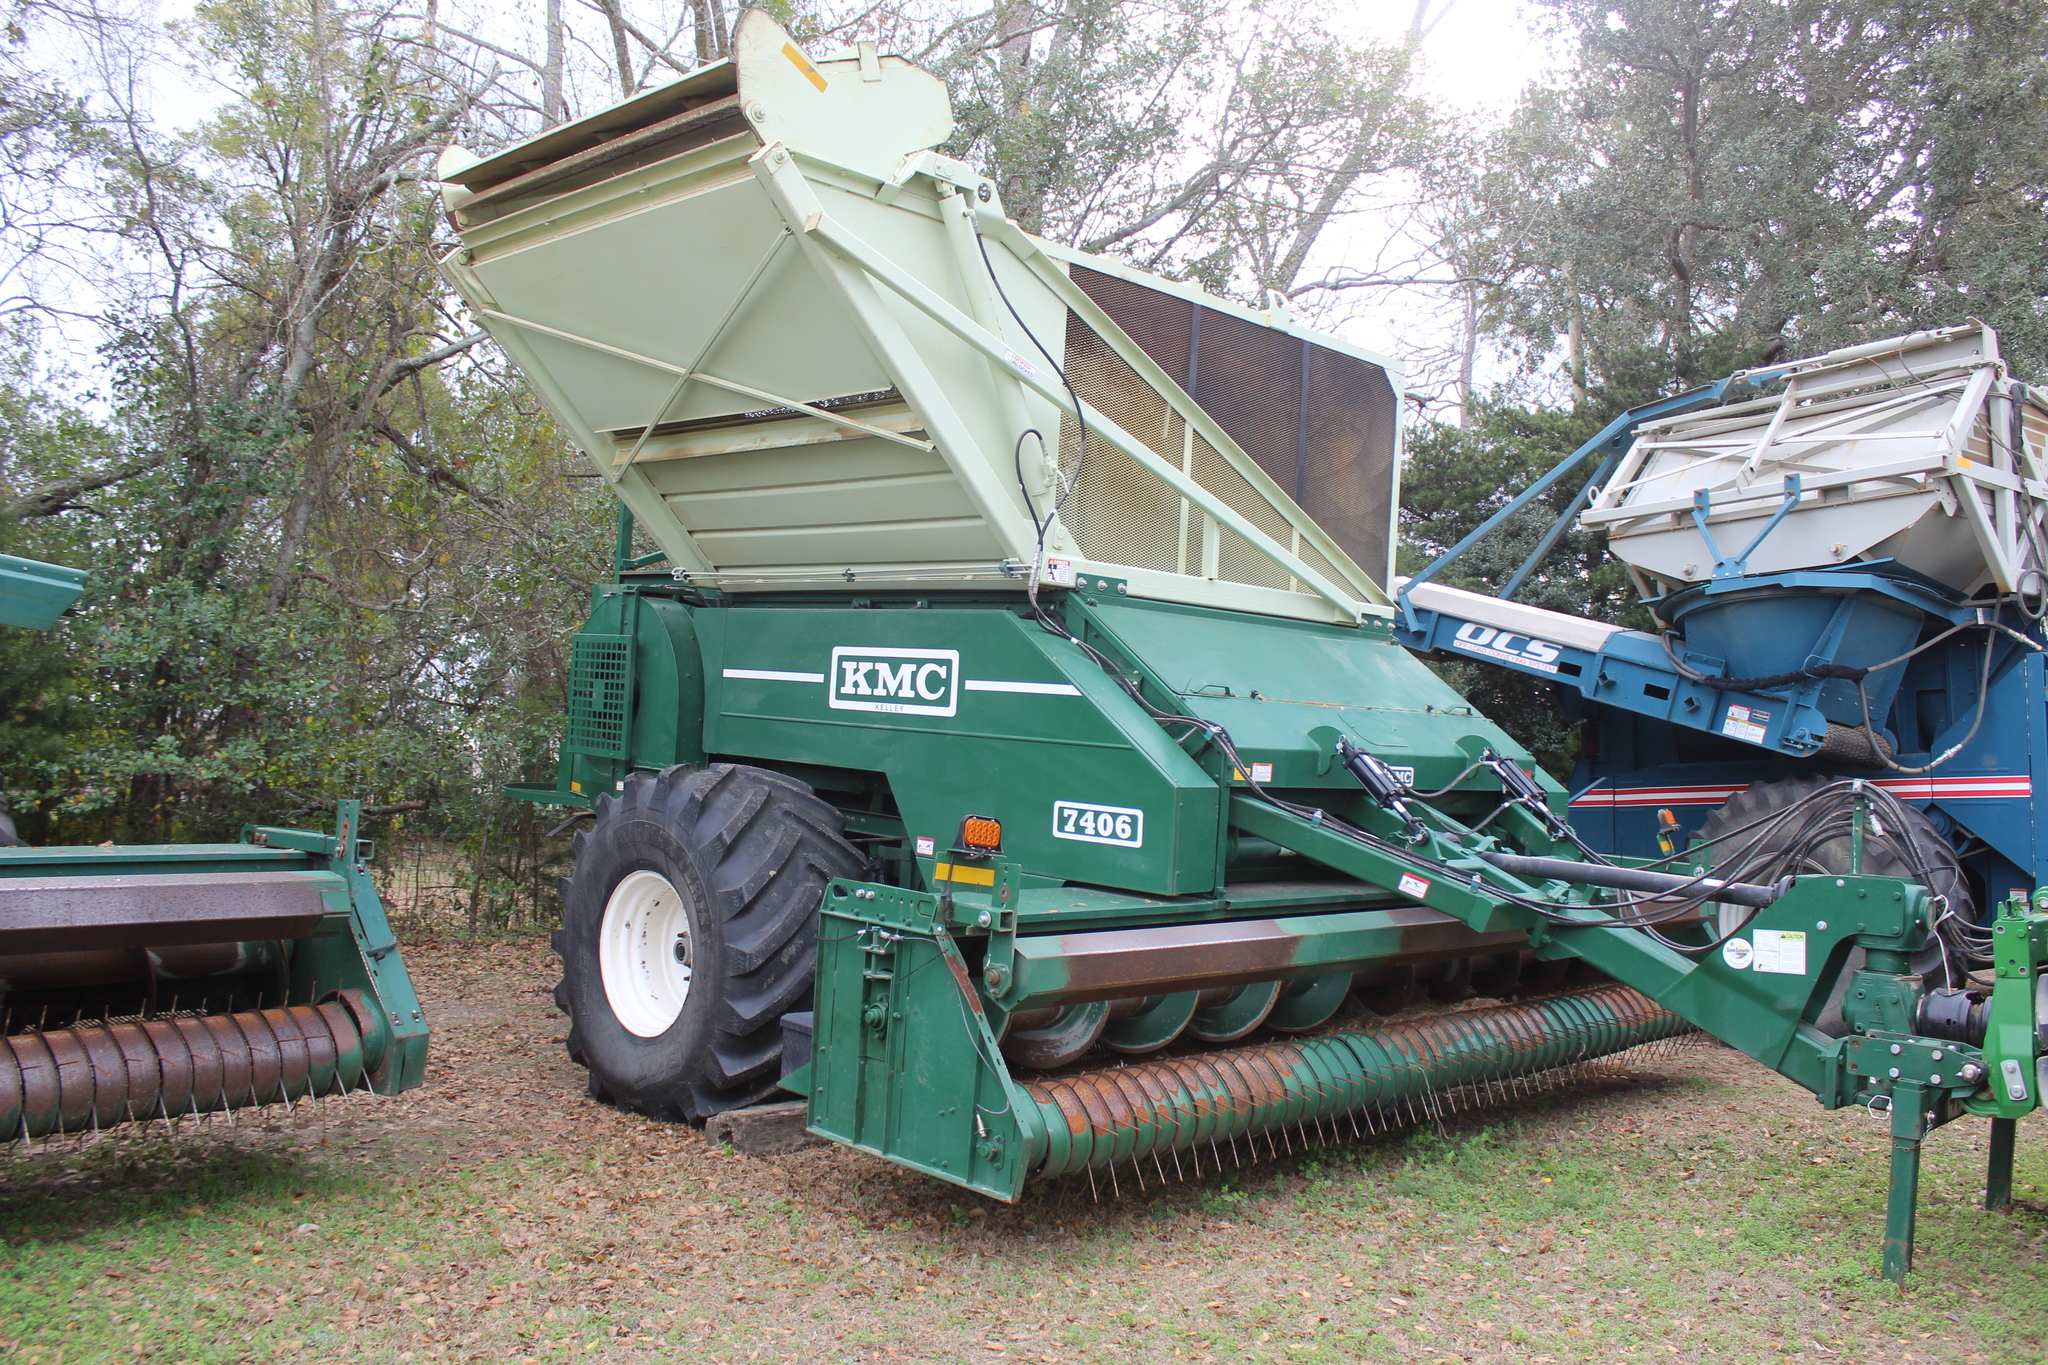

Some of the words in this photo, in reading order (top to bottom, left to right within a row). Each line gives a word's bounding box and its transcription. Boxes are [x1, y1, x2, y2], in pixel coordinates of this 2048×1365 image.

[1010, 359, 1034, 378] UNLOCKED
[1011, 354, 1031, 370] LOCKED
[1455, 622, 1564, 663] OCS
[1455, 640, 1487, 654] OFF-LOAD
[1488, 649, 1527, 665] CONVEYING
[1528, 660, 1556, 673] SYSTEM
[840, 660, 948, 701] KMC
[875, 703, 905, 713] KELLEY
[1063, 808, 1132, 840] 7406
